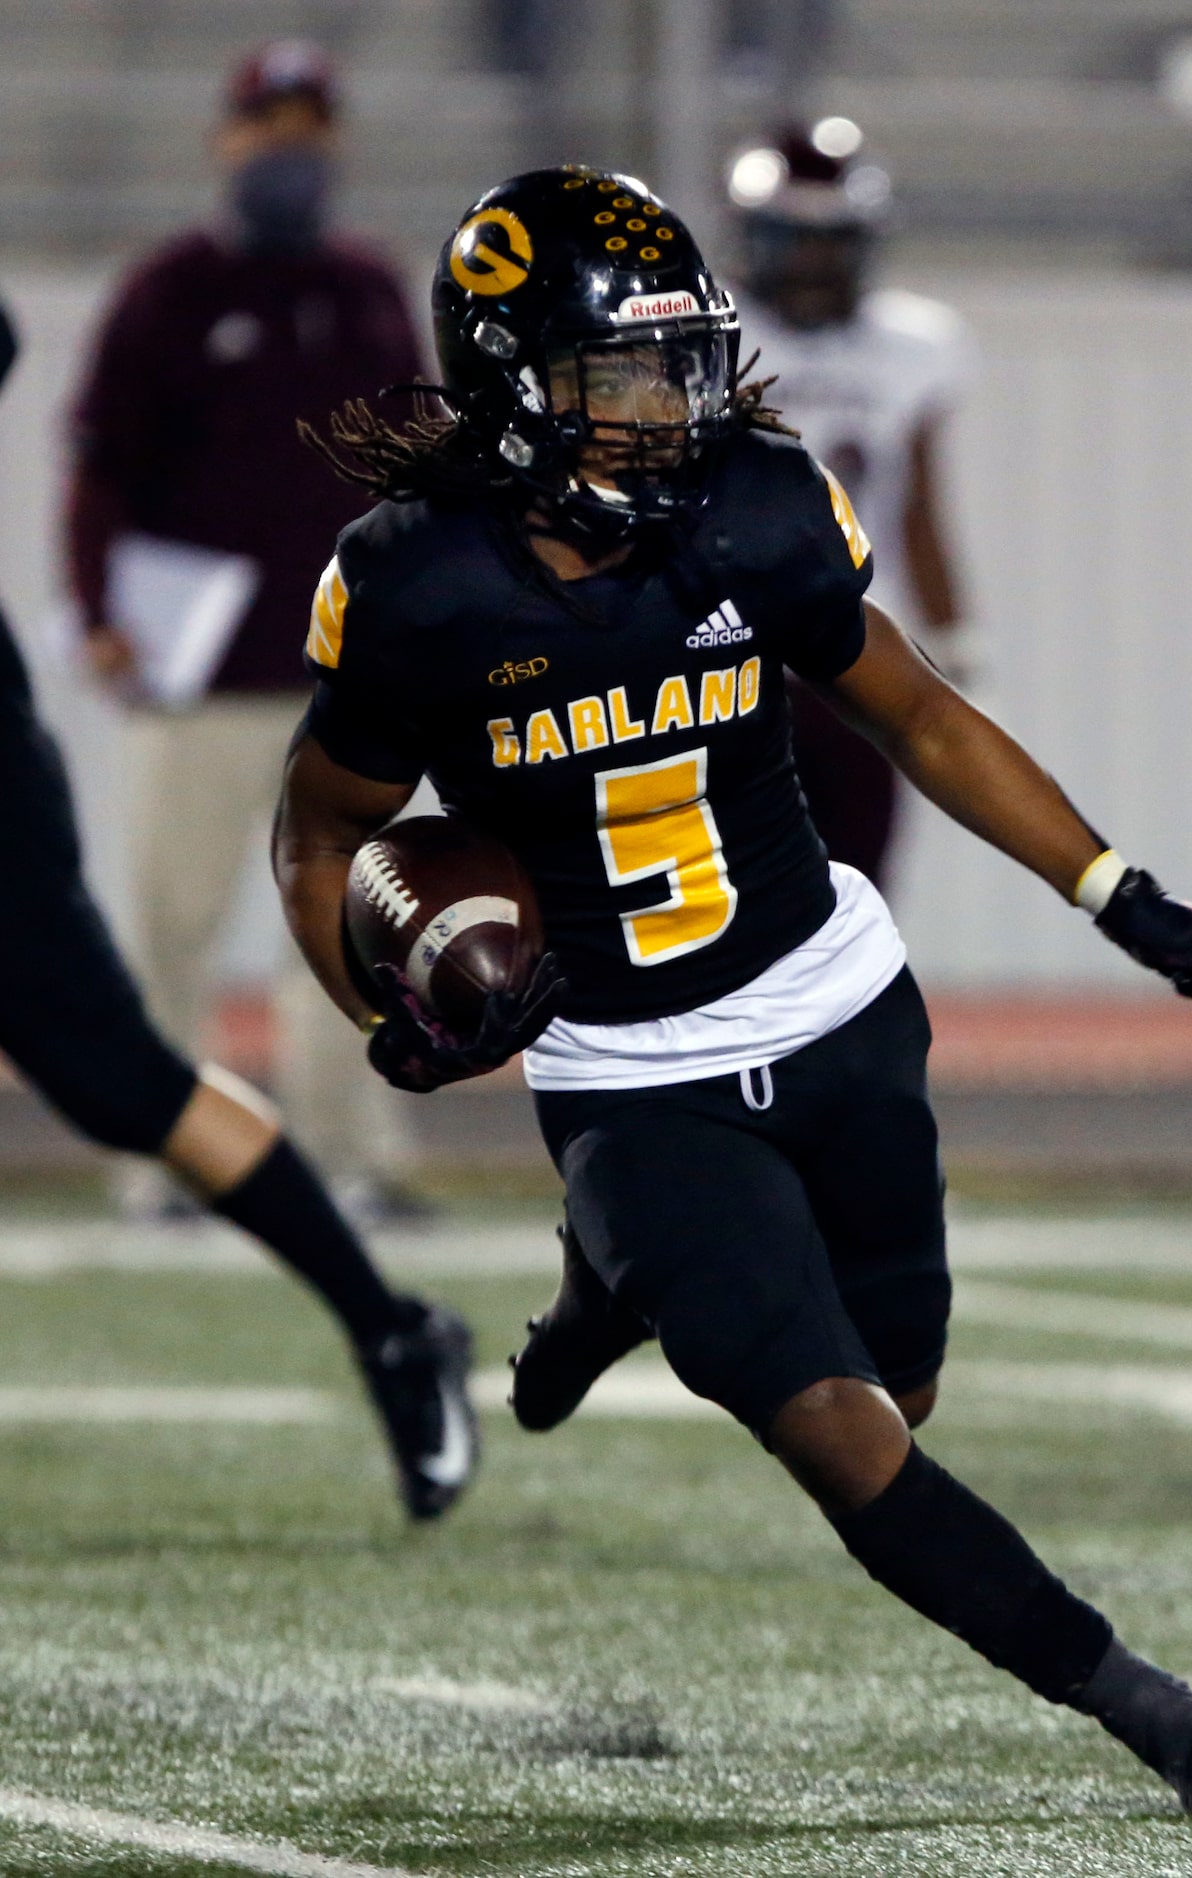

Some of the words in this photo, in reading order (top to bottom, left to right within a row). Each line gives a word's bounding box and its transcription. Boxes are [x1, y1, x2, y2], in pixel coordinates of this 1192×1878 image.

[450, 207, 533, 296] G
[630, 296, 692, 318] Riddell
[686, 626, 753, 649] adidas
[594, 746, 738, 967] 5
